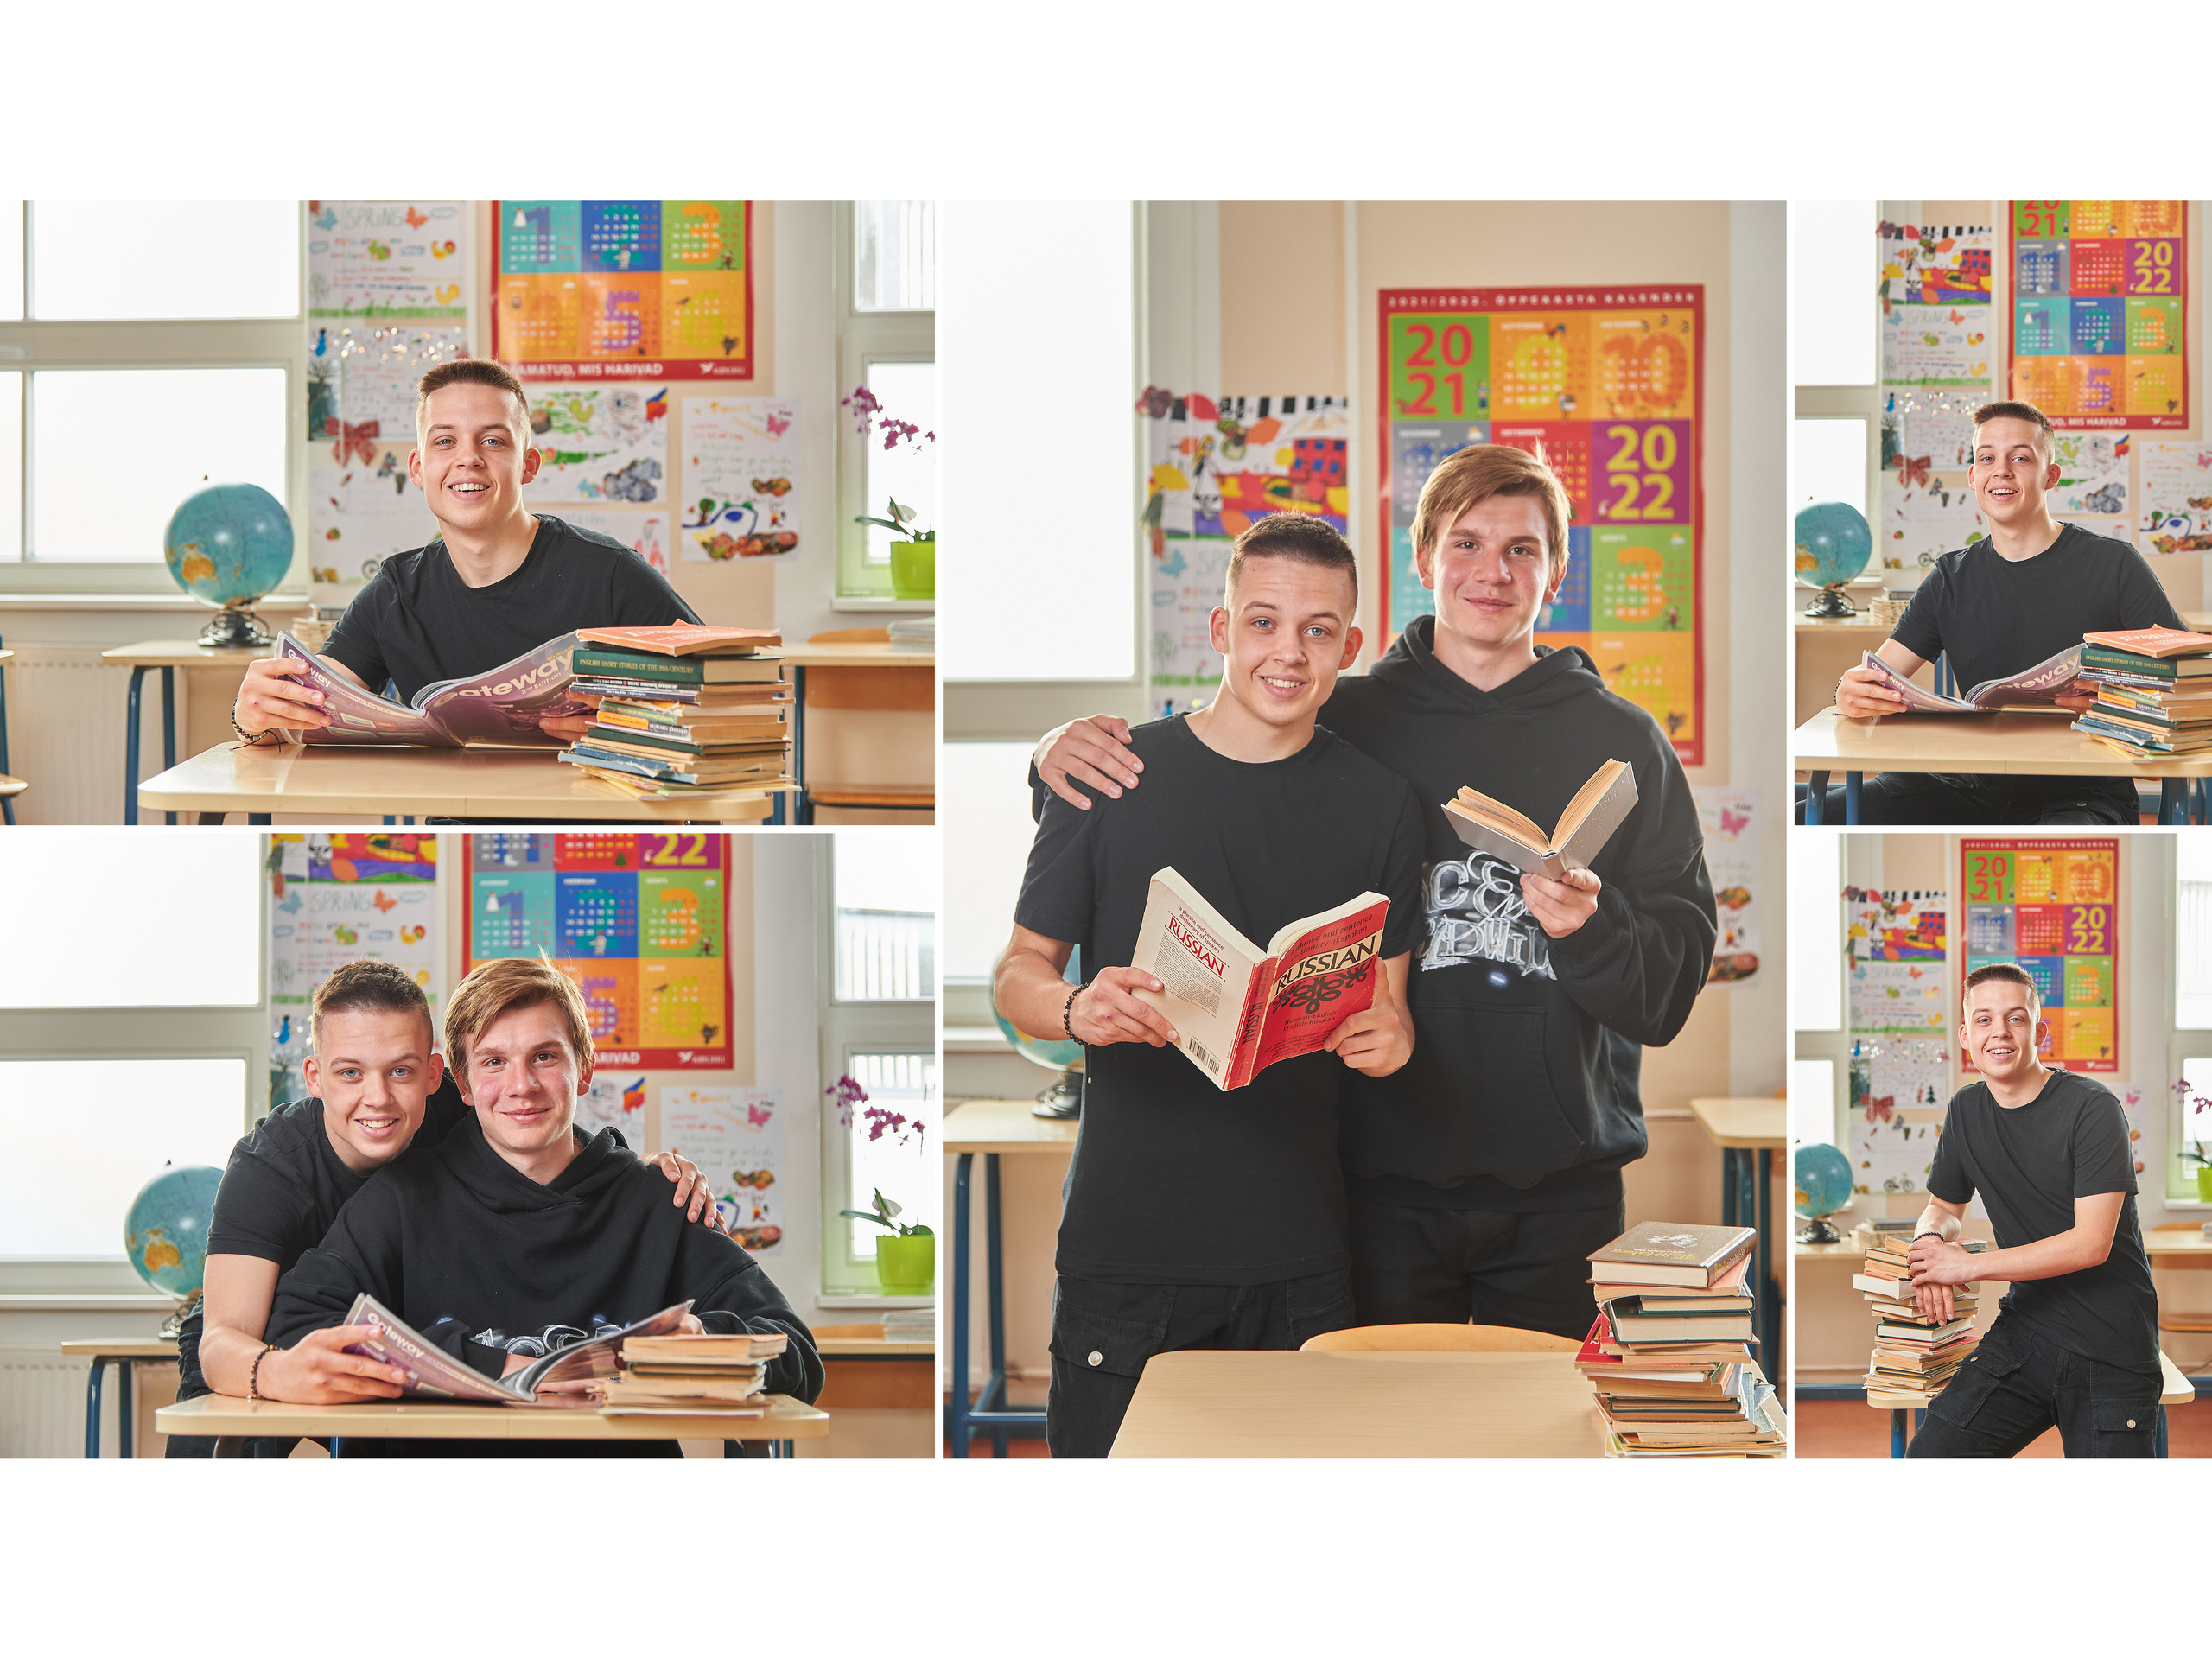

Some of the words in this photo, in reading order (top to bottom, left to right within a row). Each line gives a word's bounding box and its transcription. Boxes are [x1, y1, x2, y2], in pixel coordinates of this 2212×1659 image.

[682, 202, 722, 264] 3
[2023, 213, 2056, 237] 21
[2133, 241, 2172, 267] 20
[2134, 268, 2171, 293] 22
[602, 290, 642, 351] 5
[681, 289, 727, 349] 6
[1405, 322, 1474, 368] 20
[604, 363, 663, 375] HARIVAD
[1515, 334, 1568, 410] 9
[1602, 333, 1688, 406] 10
[1405, 371, 1465, 416] 21
[1605, 424, 1678, 471] 20
[1608, 473, 1674, 518] 22
[1614, 545, 1668, 623] 3
[534, 672, 562, 690] Edition
[580, 658, 600, 667] ENGLISH
[618, 661, 639, 670] STORIES
[669, 665, 695, 674] CENTURY
[1974, 855, 2007, 878] 20
[1974, 880, 2003, 901] 21
[659, 887, 702, 951] 3
[1322, 929, 1338, 939] and
[1340, 914, 1373, 933] sentence
[1341, 925, 1367, 943] spoken
[2071, 906, 2106, 930] 20
[1168, 916, 1224, 976] RUSSIAN
[2072, 931, 2105, 953] 22
[1275, 935, 1376, 996] RUSSIAN
[2075, 965, 2101, 1003] 3
[658, 976, 707, 1038] 6
[1242, 1002, 1263, 1045] RUSSIAN
